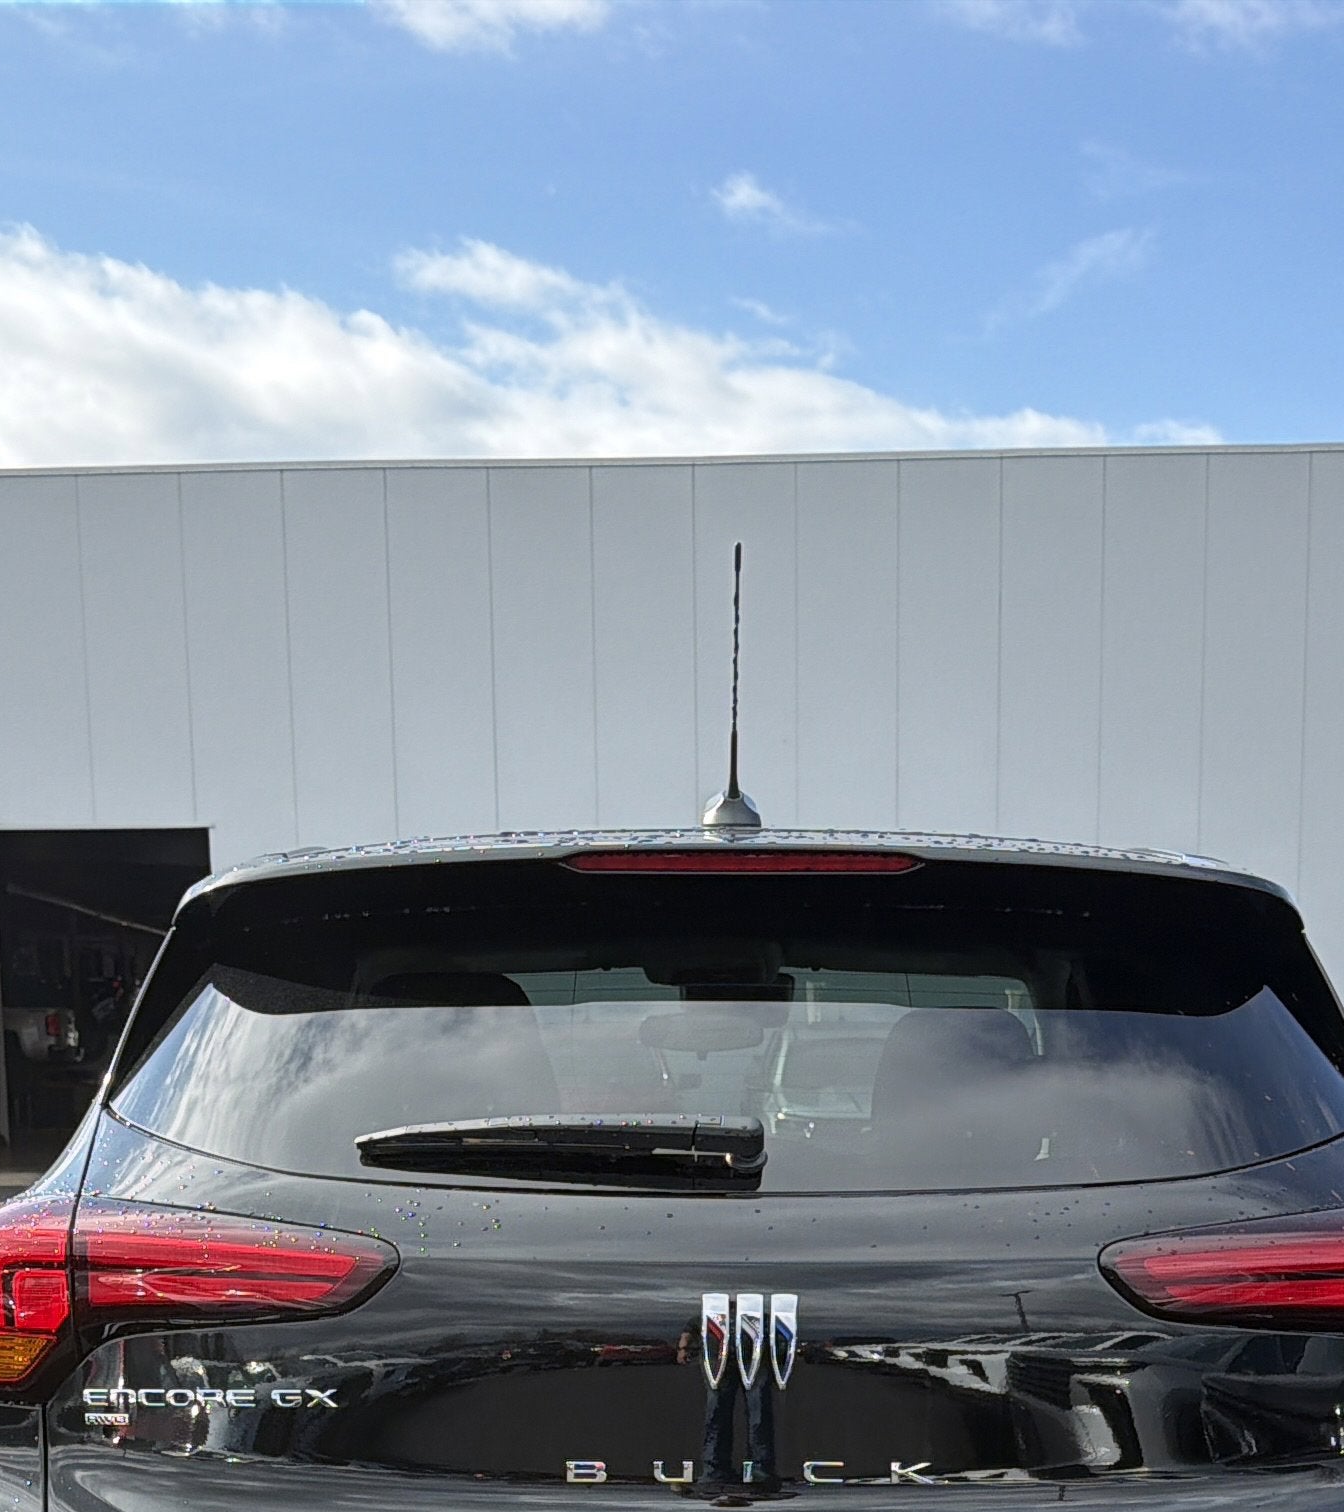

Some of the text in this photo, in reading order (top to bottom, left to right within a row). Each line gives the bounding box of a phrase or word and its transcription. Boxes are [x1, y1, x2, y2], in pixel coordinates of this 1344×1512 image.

[83, 1388, 339, 1408] ENCORE GX
[566, 1460, 935, 1483] BUICK
